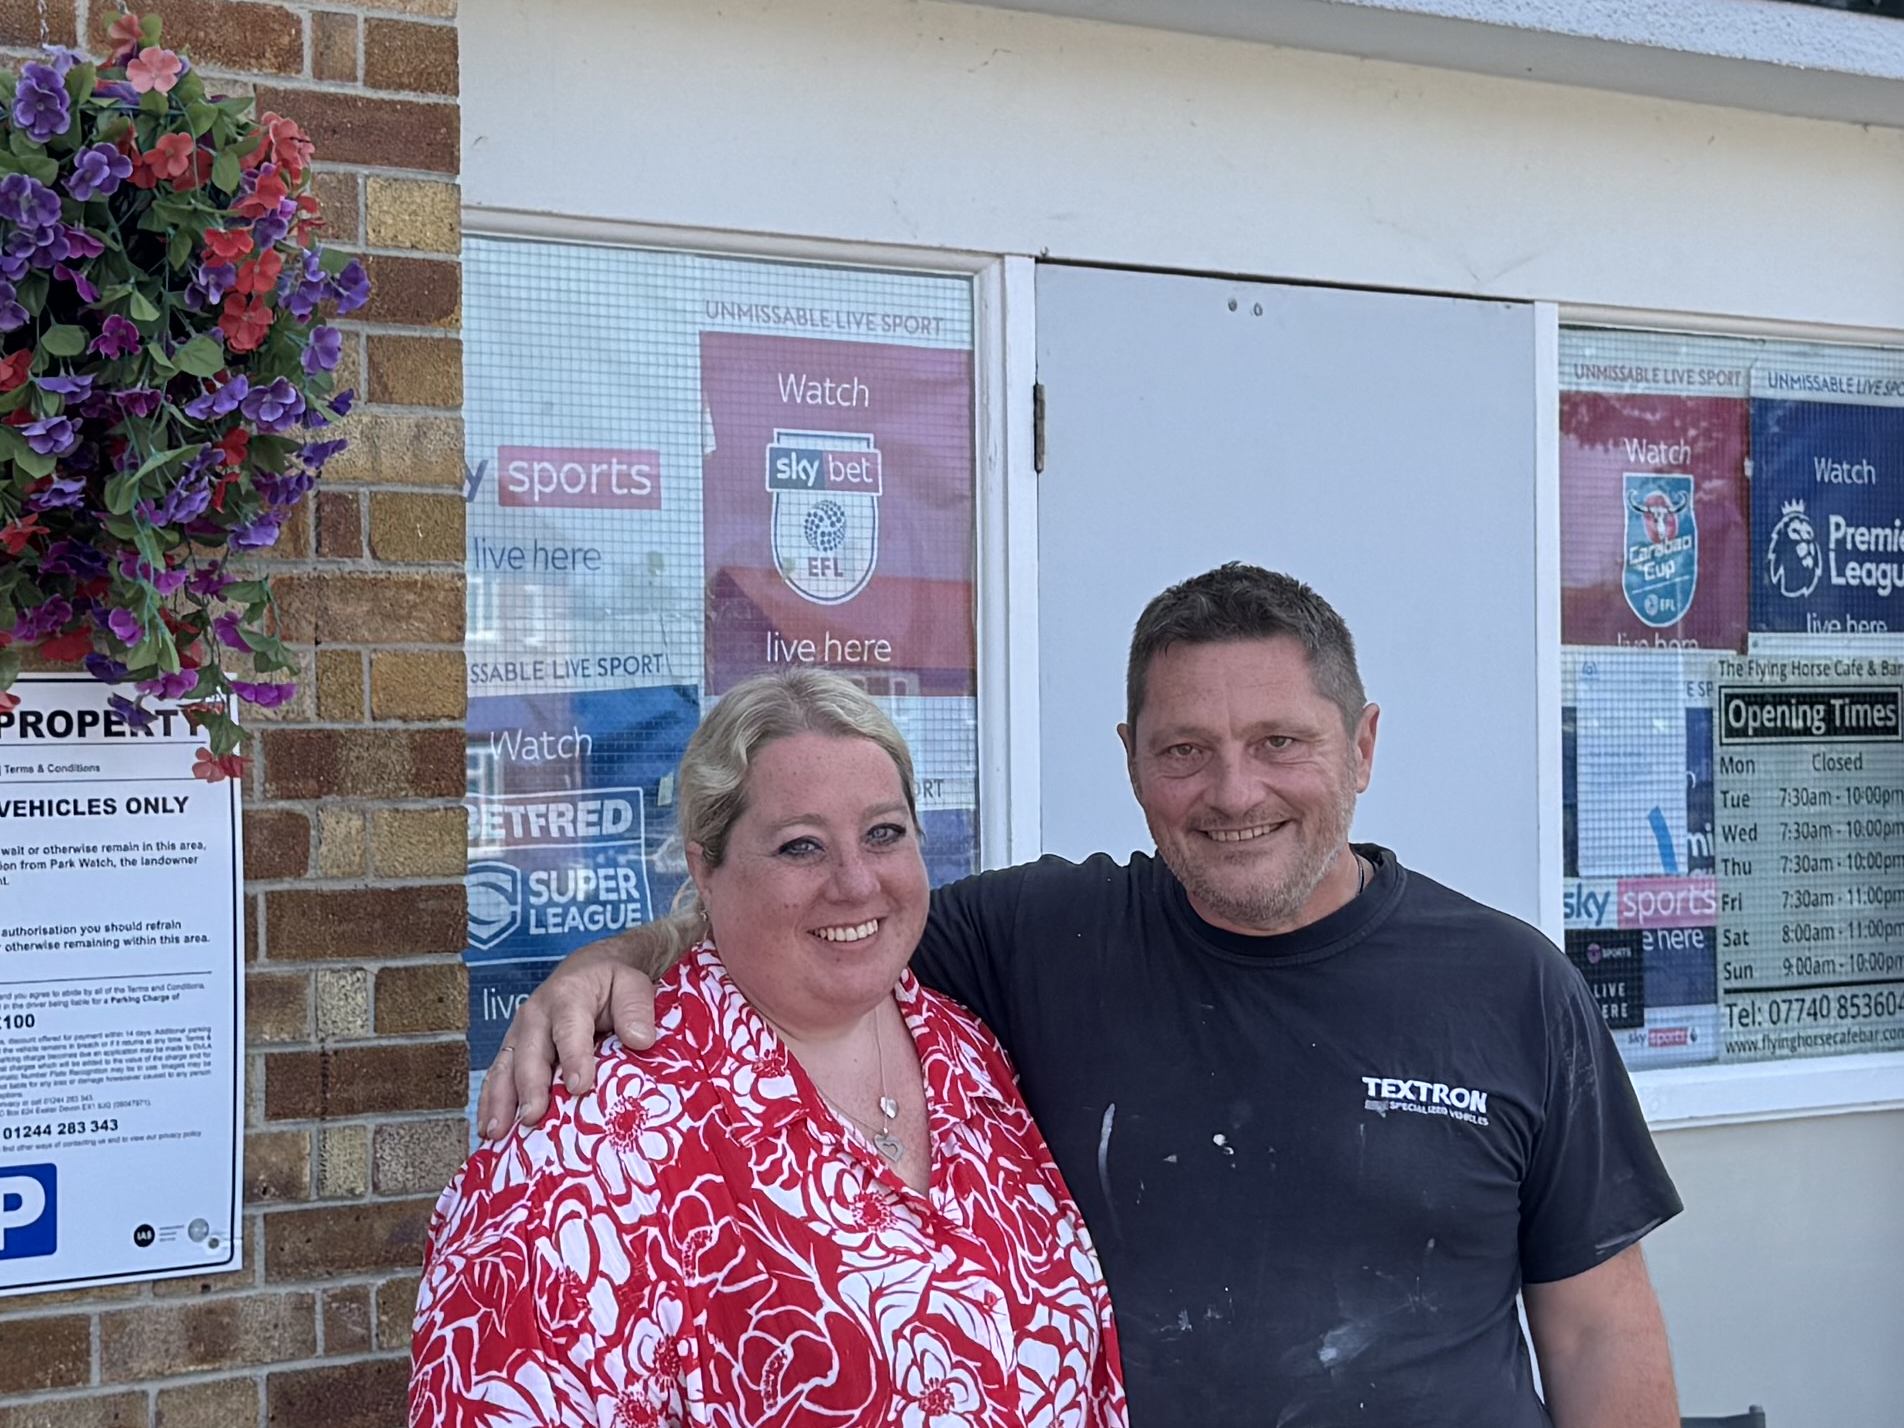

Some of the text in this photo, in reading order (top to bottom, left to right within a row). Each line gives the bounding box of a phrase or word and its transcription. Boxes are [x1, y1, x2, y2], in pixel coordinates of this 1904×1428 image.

[706, 300, 943, 336] UNMISSABLE LIVE SPORT
[1574, 363, 1743, 387] UNMISSABLE LIVE SPORT
[1768, 372, 1854, 394] UNMISSABLE
[1856, 377, 1883, 395] LIVE
[779, 372, 870, 408] Watch
[1624, 437, 1692, 465] Watch
[508, 457, 651, 502] sports
[775, 452, 873, 487] sky bet
[1814, 456, 1876, 485] Watch
[473, 536, 602, 572] live here
[807, 556, 843, 578] EFL
[766, 631, 892, 662] live here
[552, 653, 663, 679] LIVE SPORT
[1718, 660, 1744, 678] The
[1747, 659, 1787, 682] Flying
[1791, 660, 1831, 678] Horse
[1834, 659, 1863, 677] Cafe
[1867, 660, 1877, 677] &
[1728, 698, 1897, 735] Opening Times
[490, 725, 593, 762] Watch
[1719, 751, 1863, 775] Mon Closed
[124, 795, 189, 814] ONLY
[1720, 790, 1751, 809] Tue
[1778, 787, 1832, 808] 7:30am
[1721, 822, 1758, 842] Wed
[0, 845, 25, 856] wait
[27, 846, 40, 855] or
[42, 843, 98, 855] otherwise
[100, 841, 140, 853] remain
[141, 841, 153, 851] in
[155, 840, 176, 851] this
[19, 859, 47, 870] from
[49, 858, 75, 869] Park
[77, 857, 117, 868] Watch,
[119, 856, 138, 867] the
[140, 855, 198, 866] landowner
[1721, 858, 1753, 877] Thu
[529, 870, 639, 905] SUPER
[1563, 883, 1717, 925] sky sports
[1721, 893, 1743, 912] Fri
[0, 924, 77, 937] authorisation
[79, 924, 101, 937] you
[103, 920, 143, 932] should
[145, 919, 182, 931] refrain
[529, 904, 642, 936] LEAGUE
[4, 940, 61, 952] otherwise
[63, 937, 120, 949] remaining
[122, 935, 157, 946] within
[159, 934, 180, 944] this
[1722, 929, 1750, 947] Sat
[1723, 962, 1754, 981] Sun
[1594, 982, 1626, 998] LIVE
[1725, 1000, 1762, 1029] Tel:
[1768, 994, 1831, 1025] 07740
[1361, 1076, 1488, 1114] TEXTRON
[2, 1123, 52, 1140] 01244
[56, 1120, 86, 1135] 283
[89, 1118, 118, 1133] 343
